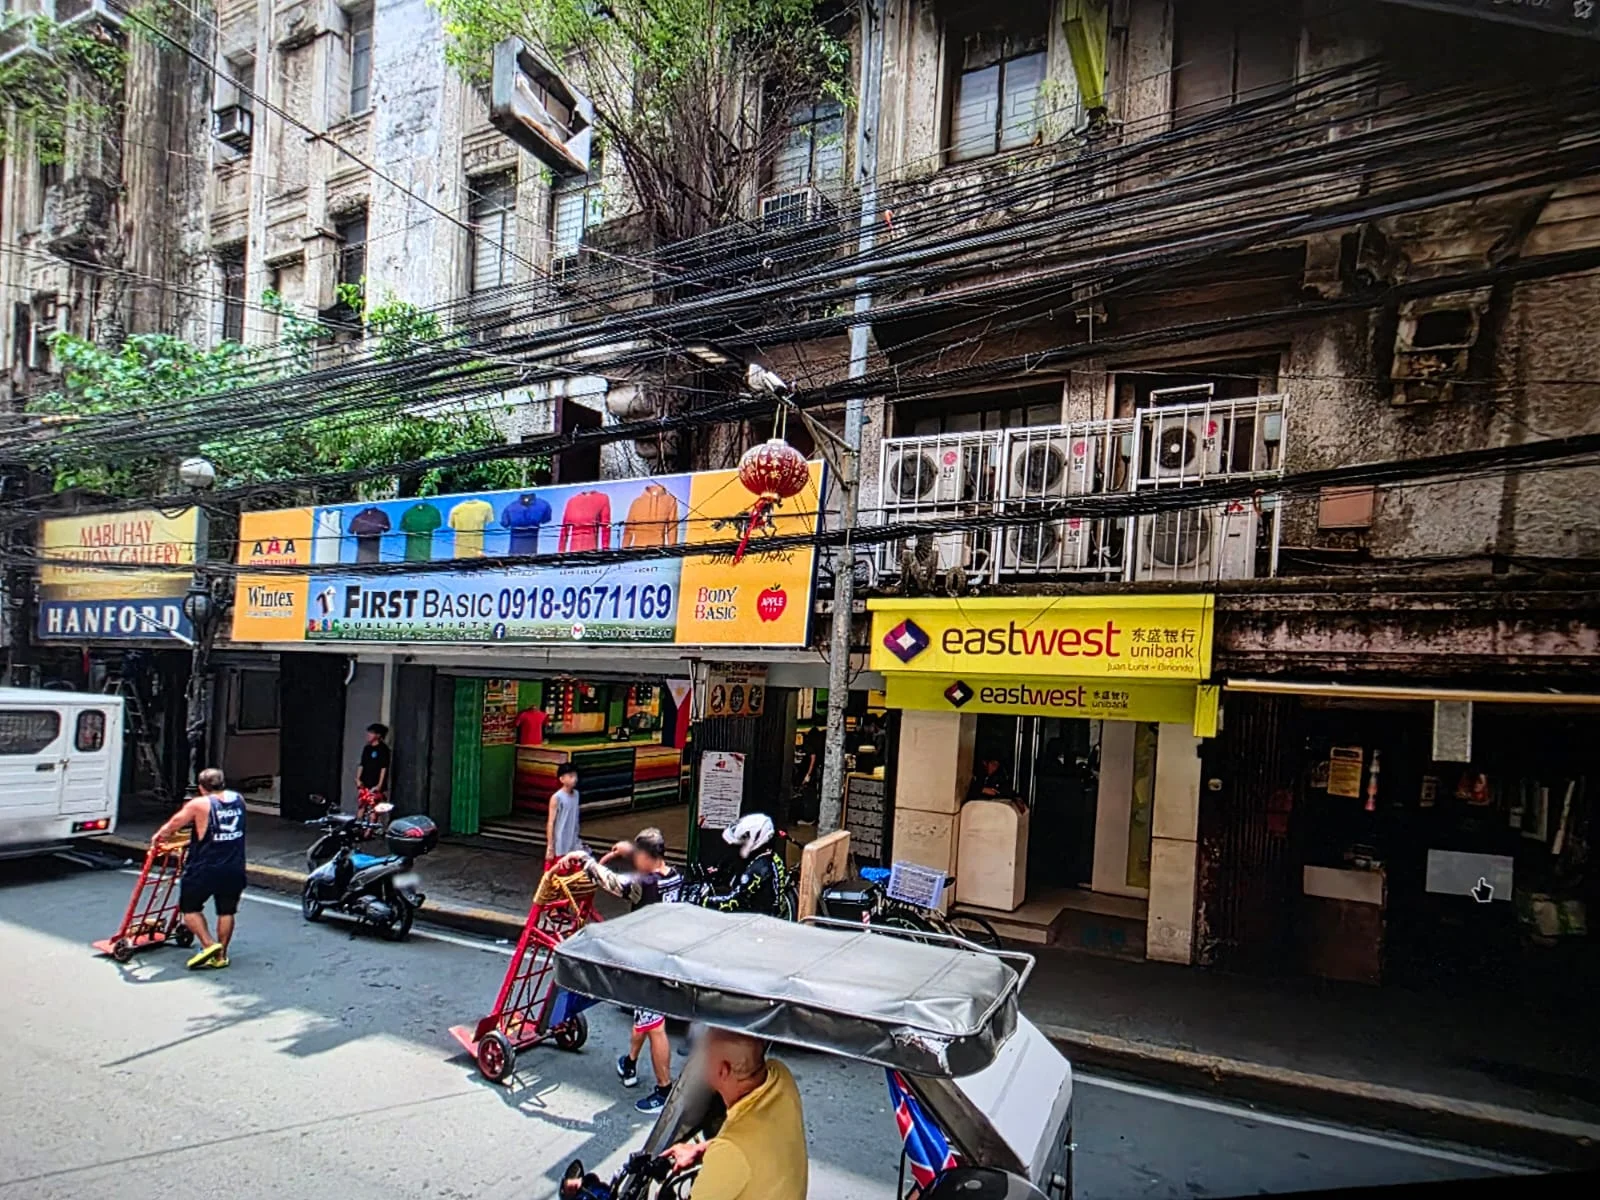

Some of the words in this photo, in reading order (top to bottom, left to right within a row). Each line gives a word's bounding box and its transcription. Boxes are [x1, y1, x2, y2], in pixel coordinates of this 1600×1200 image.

[80, 520, 154, 548] MABUHAY
[247, 585, 295, 607] Wintex
[343, 585, 420, 619] FIRST
[423, 589, 494, 619] BASIC
[499, 584, 672, 620] 0918-9671169
[697, 587, 738, 603] BODY
[761, 597, 784, 607] APPLE
[47, 604, 181, 634] HANFORD
[695, 604, 737, 619] BASIC
[342, 622, 414, 630] QUALITY
[424, 621, 491, 630] SHIRTS
[942, 620, 1121, 657] eastwest
[1130, 643, 1194, 658] unibank
[980, 684, 1087, 708] eastwest
[1091, 700, 1128, 710] unibank
